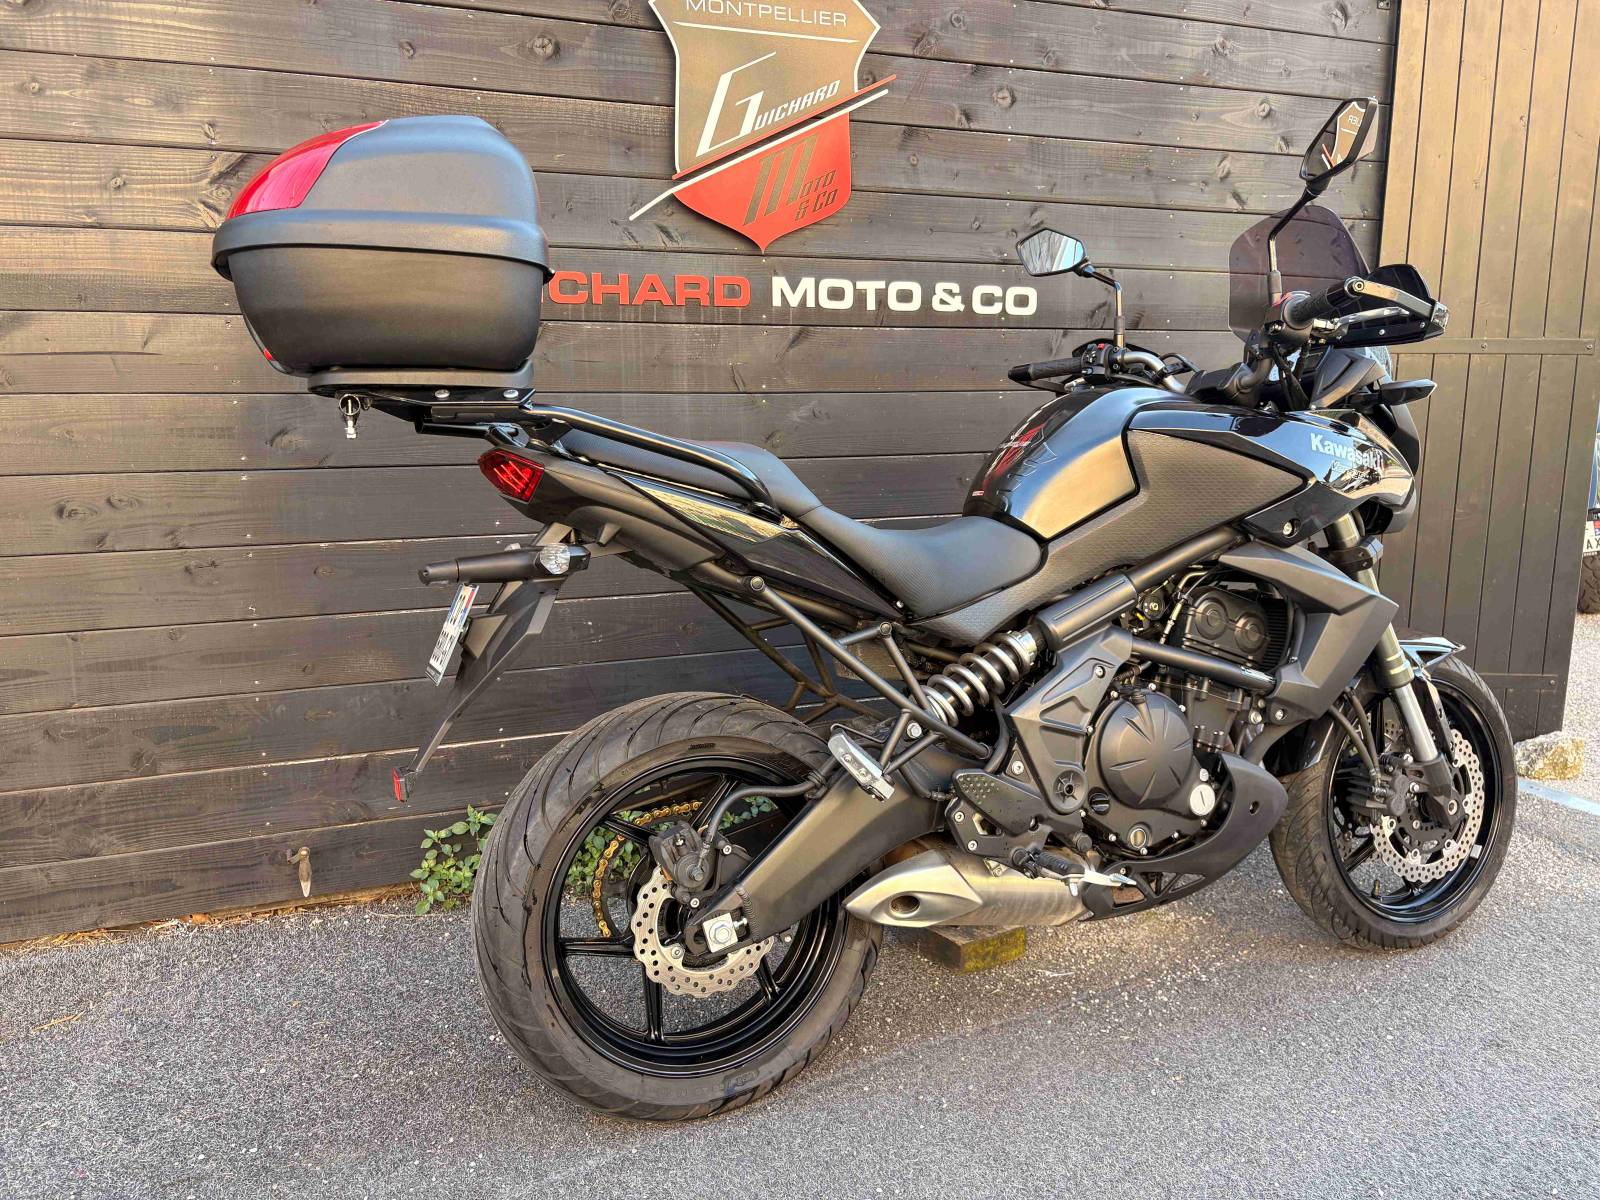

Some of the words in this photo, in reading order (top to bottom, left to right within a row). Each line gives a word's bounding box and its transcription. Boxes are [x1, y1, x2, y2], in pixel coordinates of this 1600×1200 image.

[686, 0, 847, 27] MONTPELLIER
[696, 51, 841, 158] GUICHARD
[541, 270, 751, 307] CHARD
[771, 276, 922, 311] MOTO
